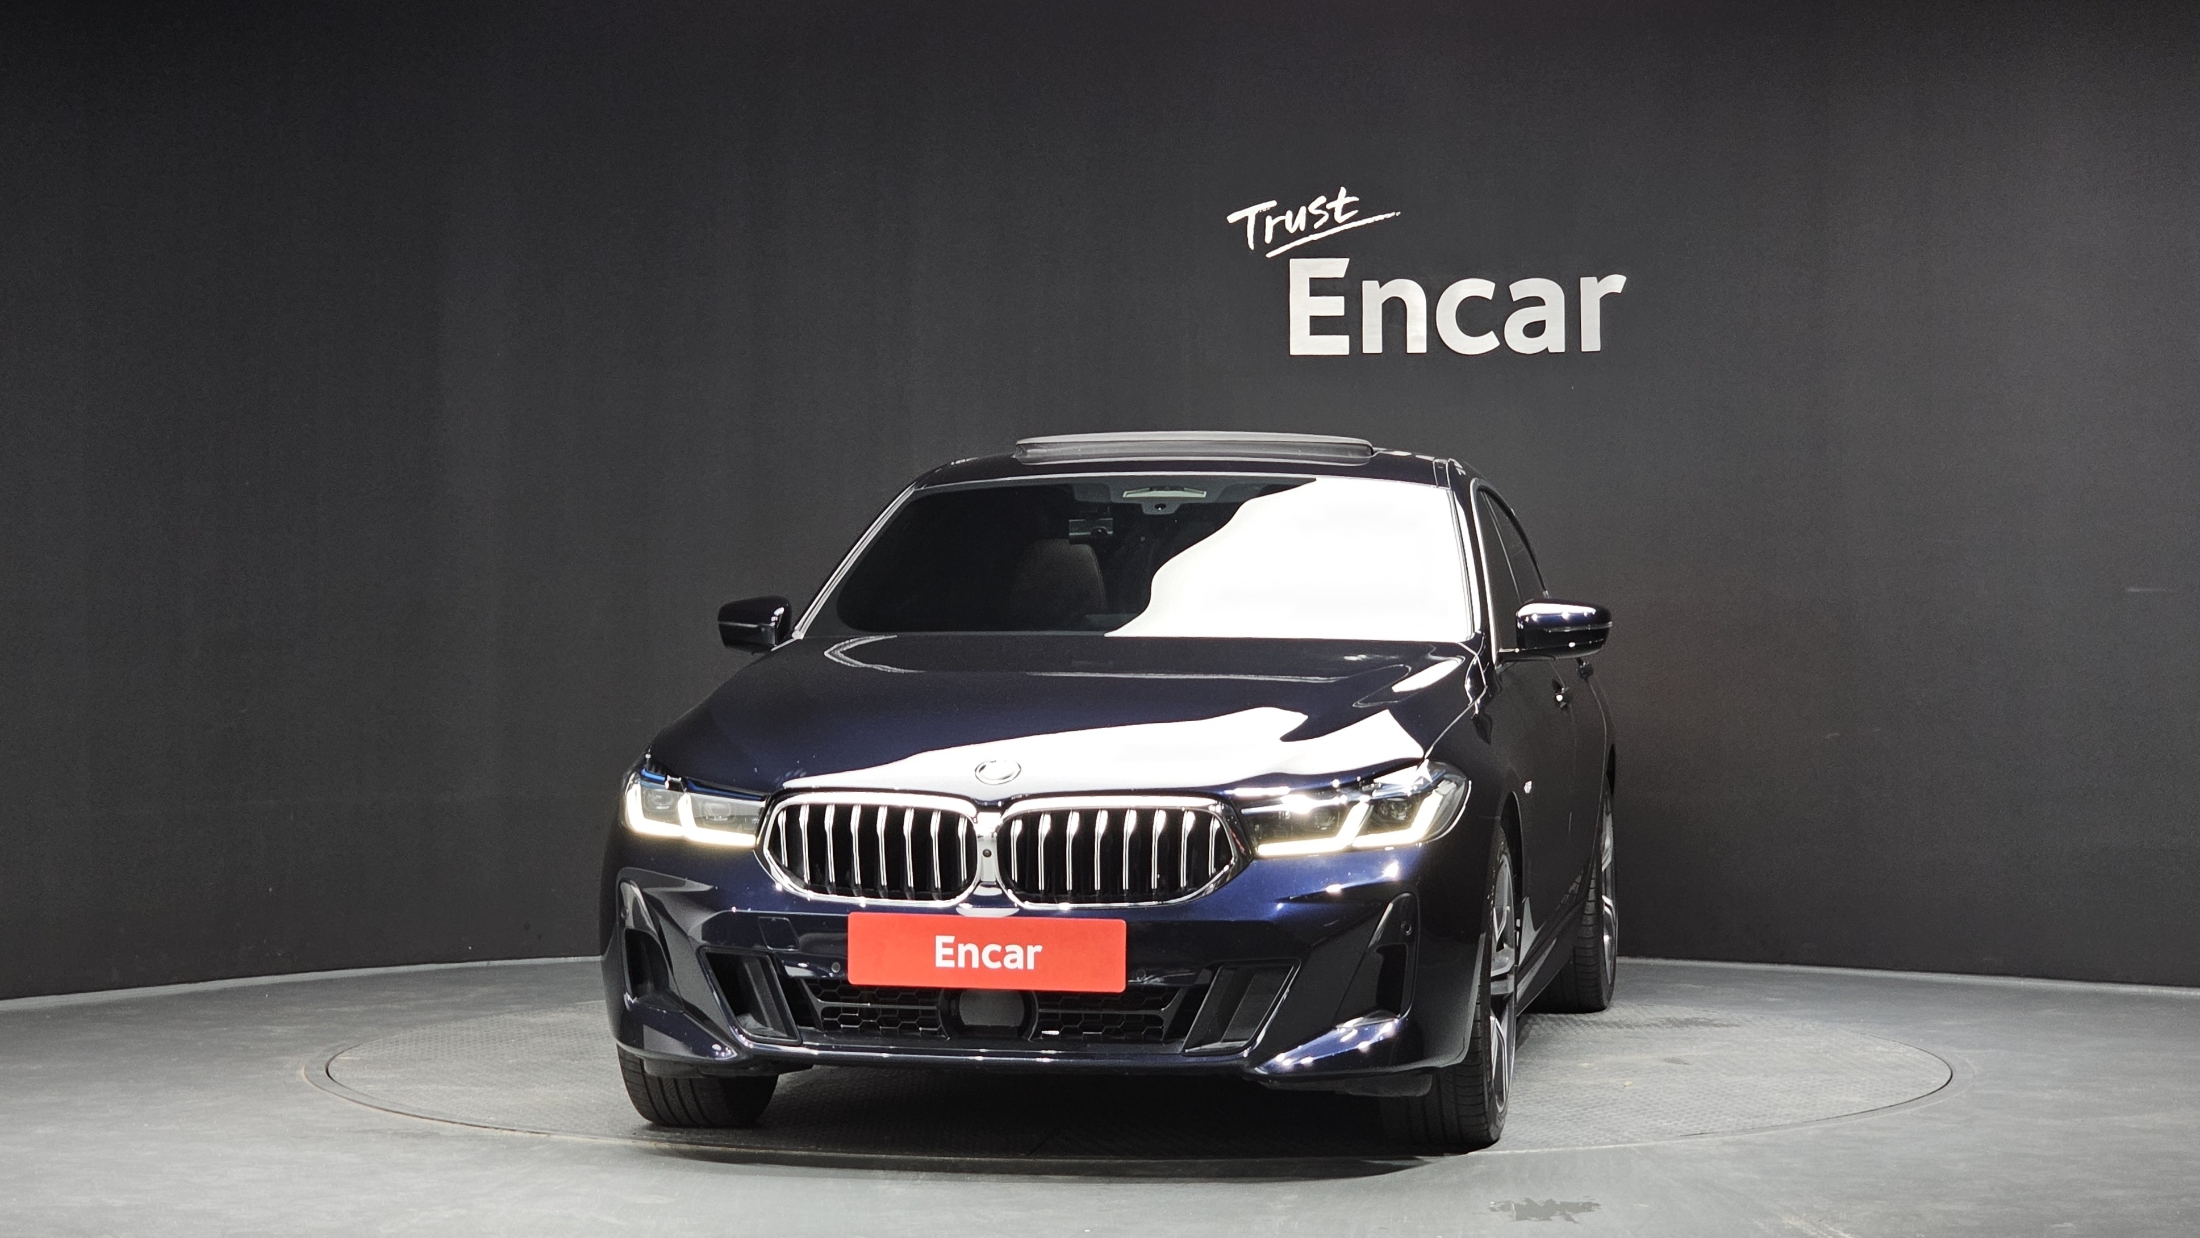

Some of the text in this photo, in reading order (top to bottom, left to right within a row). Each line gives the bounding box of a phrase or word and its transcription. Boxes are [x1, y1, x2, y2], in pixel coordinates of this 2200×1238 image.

[1227, 186, 1360, 251] Trust
[1290, 258, 1627, 356] Encar
[935, 935, 1043, 970] Encar
